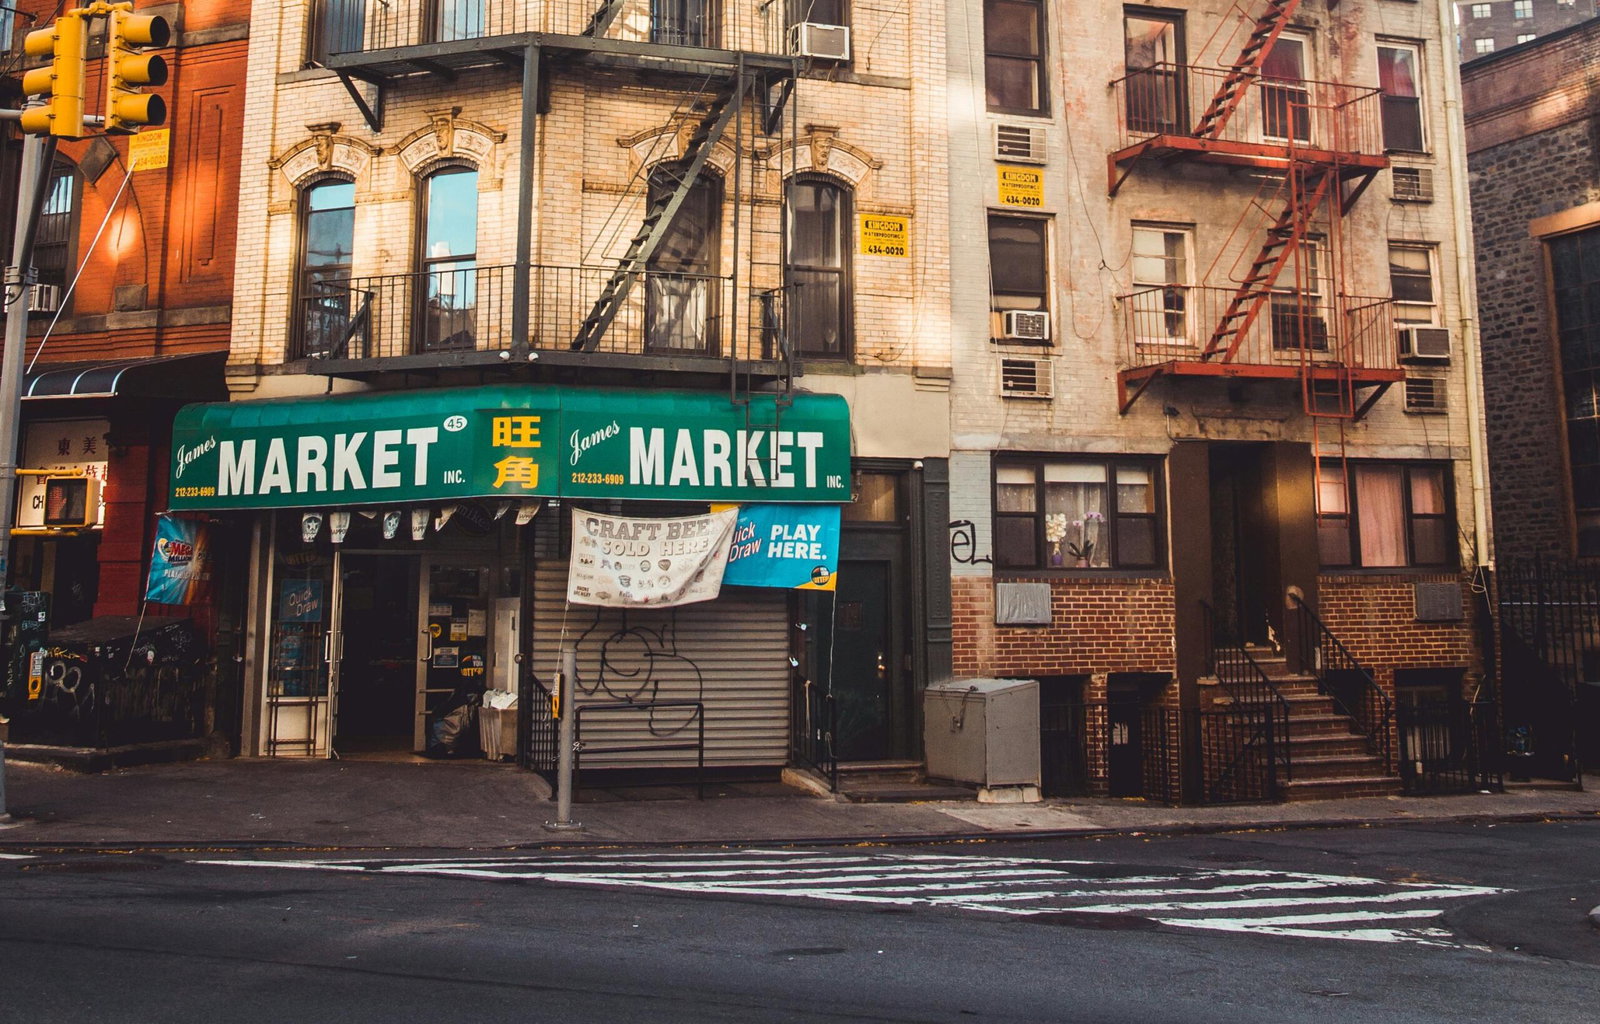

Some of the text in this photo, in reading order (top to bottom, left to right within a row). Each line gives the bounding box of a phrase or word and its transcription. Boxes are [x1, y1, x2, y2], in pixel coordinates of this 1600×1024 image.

[1005, 172, 1036, 182] KINGDOM
[1006, 195, 1040, 206] 434-0020
[867, 220, 900, 231] KINGDOM
[868, 245, 904, 256] 434-0020
[446, 417, 464, 430] 45
[175, 426, 466, 496] James MARKET INC.
[492, 416, 541, 489] 旺角
[570, 420, 845, 489] James MARKET INC.
[572, 472, 624, 485] 212-233-6909
[175, 486, 215, 497] 212-233-6909
[586, 517, 714, 541] CRAFT BEE
[731, 521, 756, 546] uick
[770, 524, 822, 541] PLAY
[602, 538, 708, 556] SOLD HERE
[728, 538, 762, 563] Draw
[767, 542, 828, 560] HERE.
[288, 586, 313, 606] Quick
[296, 598, 319, 616] Draw
